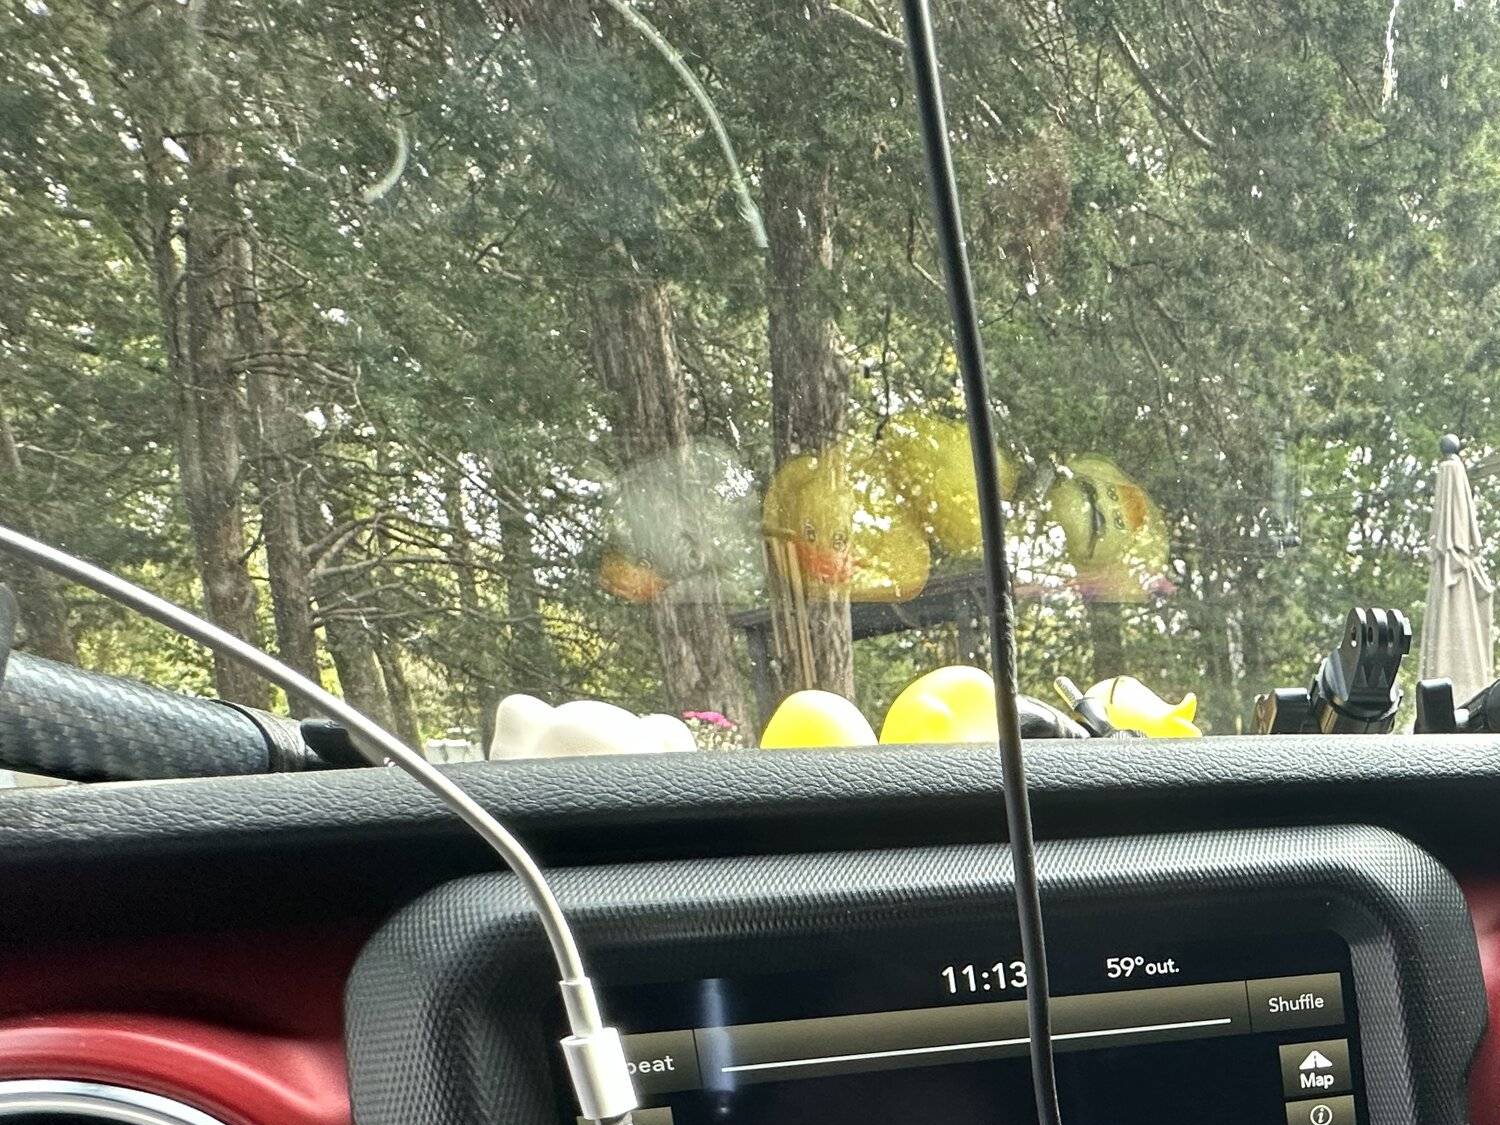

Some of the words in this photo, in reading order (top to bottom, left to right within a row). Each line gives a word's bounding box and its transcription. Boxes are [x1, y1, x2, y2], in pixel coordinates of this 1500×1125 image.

[941, 960, 1029, 995] 11:13
[1268, 994, 1325, 1014] Shuffle
[1300, 1071, 1335, 1090] Map
